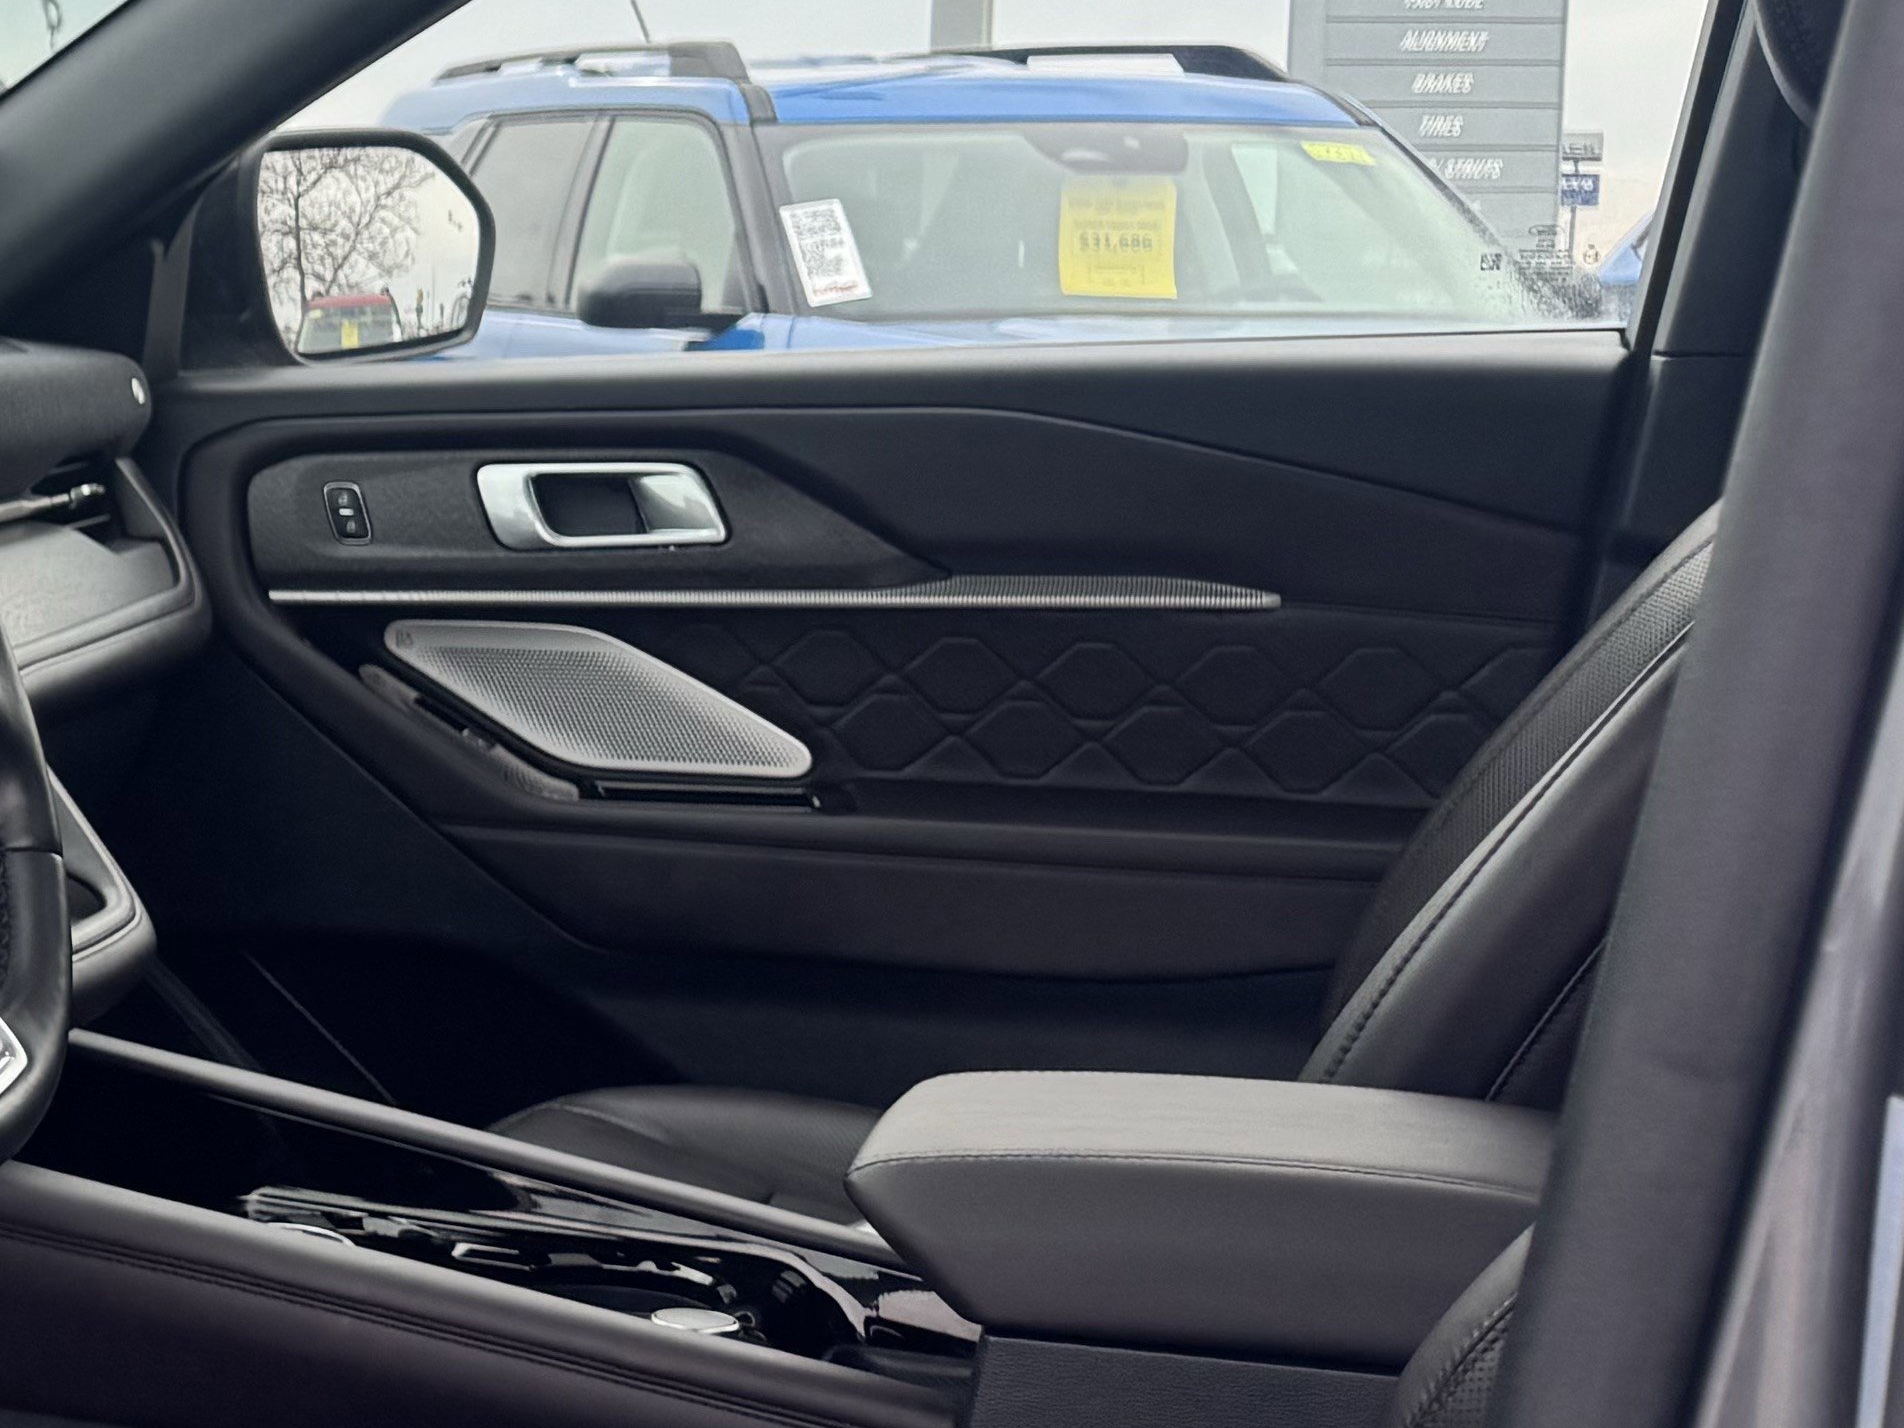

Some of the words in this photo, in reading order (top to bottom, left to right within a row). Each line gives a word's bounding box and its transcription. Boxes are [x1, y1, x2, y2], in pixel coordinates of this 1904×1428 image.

[1399, 29, 1489, 52] ALIGNMENT
[1411, 72, 1474, 93] BRAKES
[1419, 114, 1463, 137] TIRES
[1444, 158, 1504, 180] STRUTS
